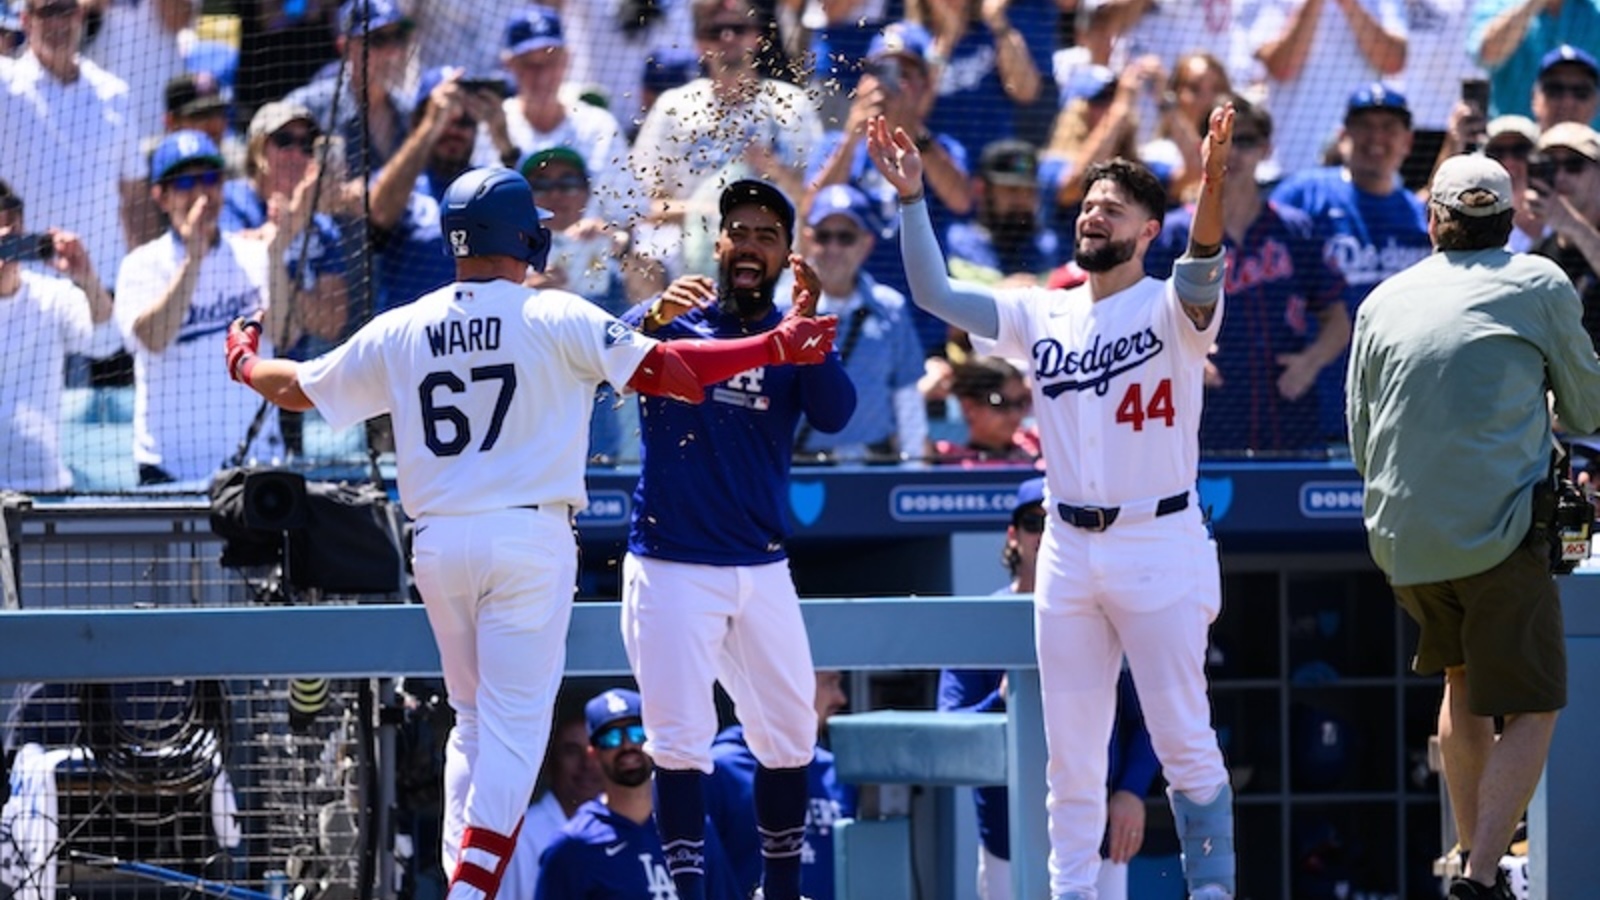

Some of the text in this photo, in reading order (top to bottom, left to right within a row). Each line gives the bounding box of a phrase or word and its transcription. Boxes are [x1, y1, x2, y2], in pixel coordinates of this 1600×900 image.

[450, 229, 467, 246] 67
[426, 317, 501, 358] WARD
[1032, 327, 1163, 399] Dodgers
[418, 363, 517, 457] 67
[1115, 378, 1175, 432] 44
[638, 852, 680, 900] LA
